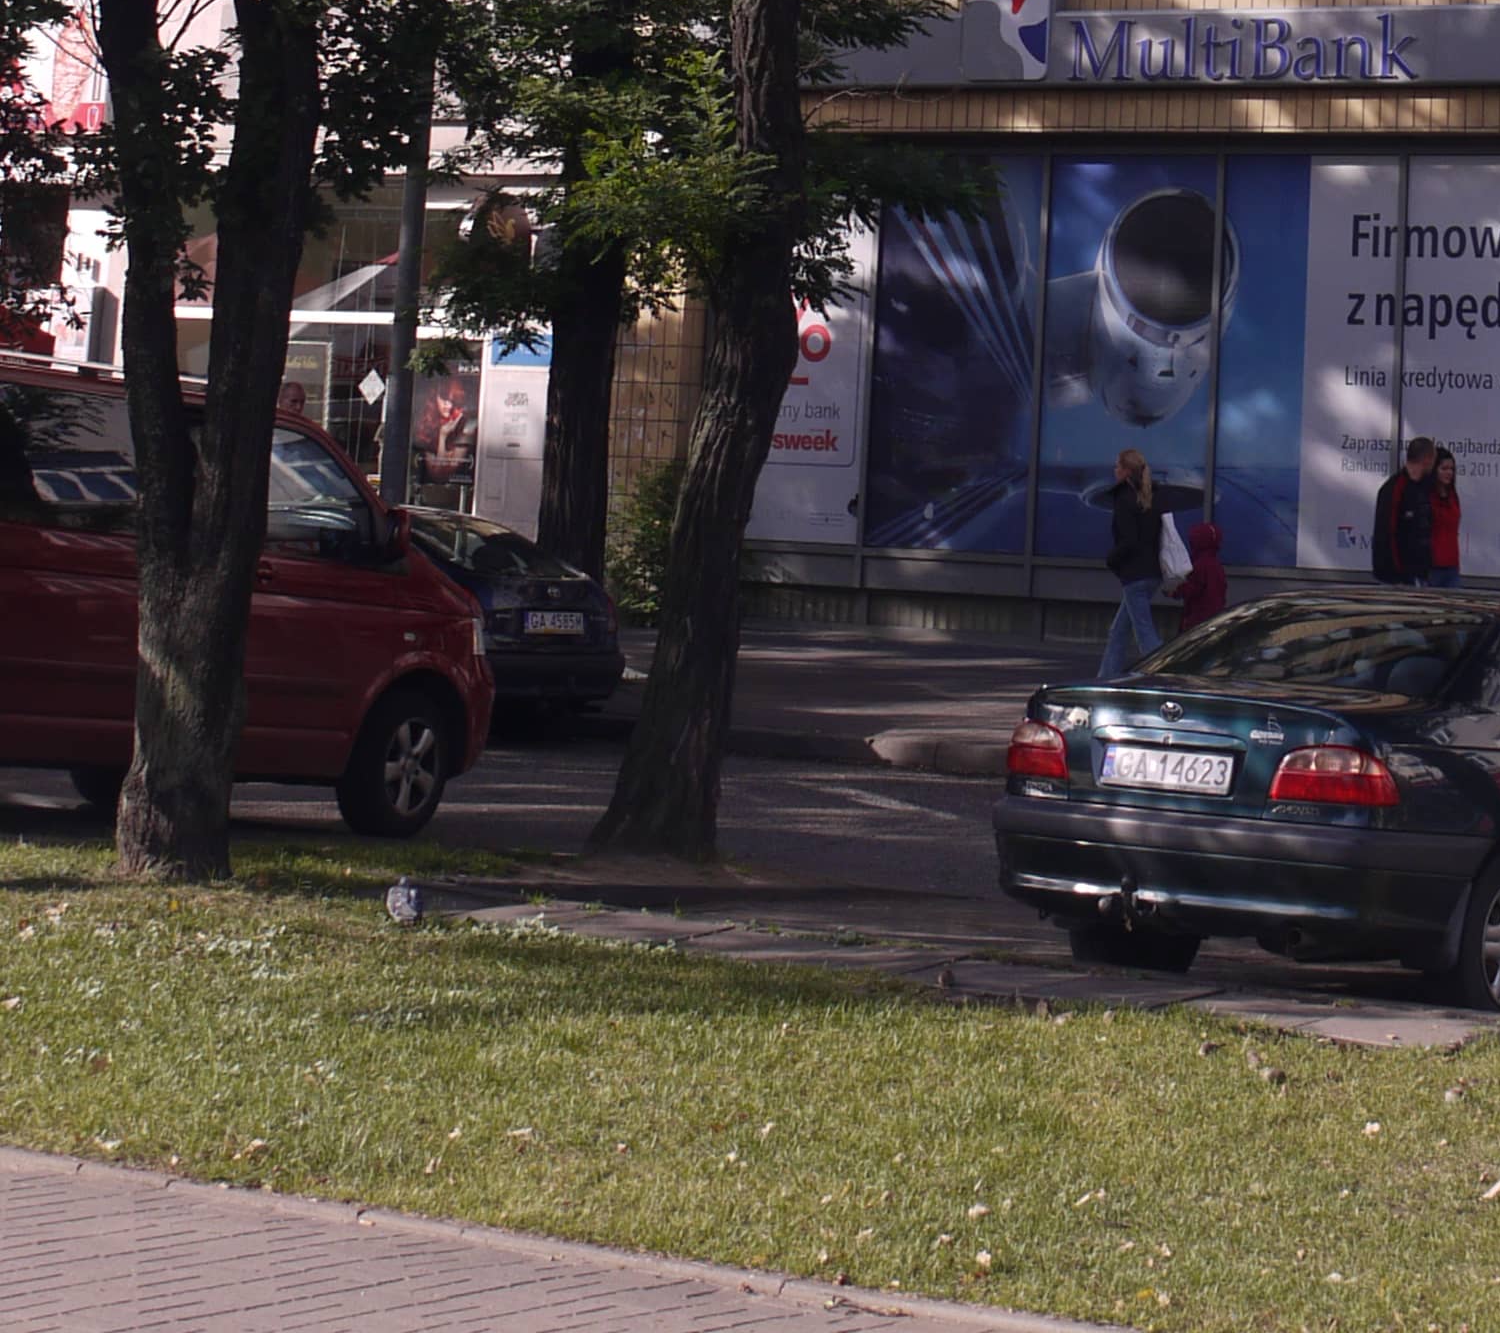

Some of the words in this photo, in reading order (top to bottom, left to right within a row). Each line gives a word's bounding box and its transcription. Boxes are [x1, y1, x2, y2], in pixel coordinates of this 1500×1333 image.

[1067, 12, 1421, 83] MultiBank
[1344, 365, 1386, 387] Linia
[1401, 366, 1493, 394] kredytowa
[804, 400, 841, 420] bank
[770, 430, 838, 452] sweek
[1470, 462, 1499, 478] 2011
[1117, 745, 1149, 780] GA
[1158, 752, 1230, 786] 14623
